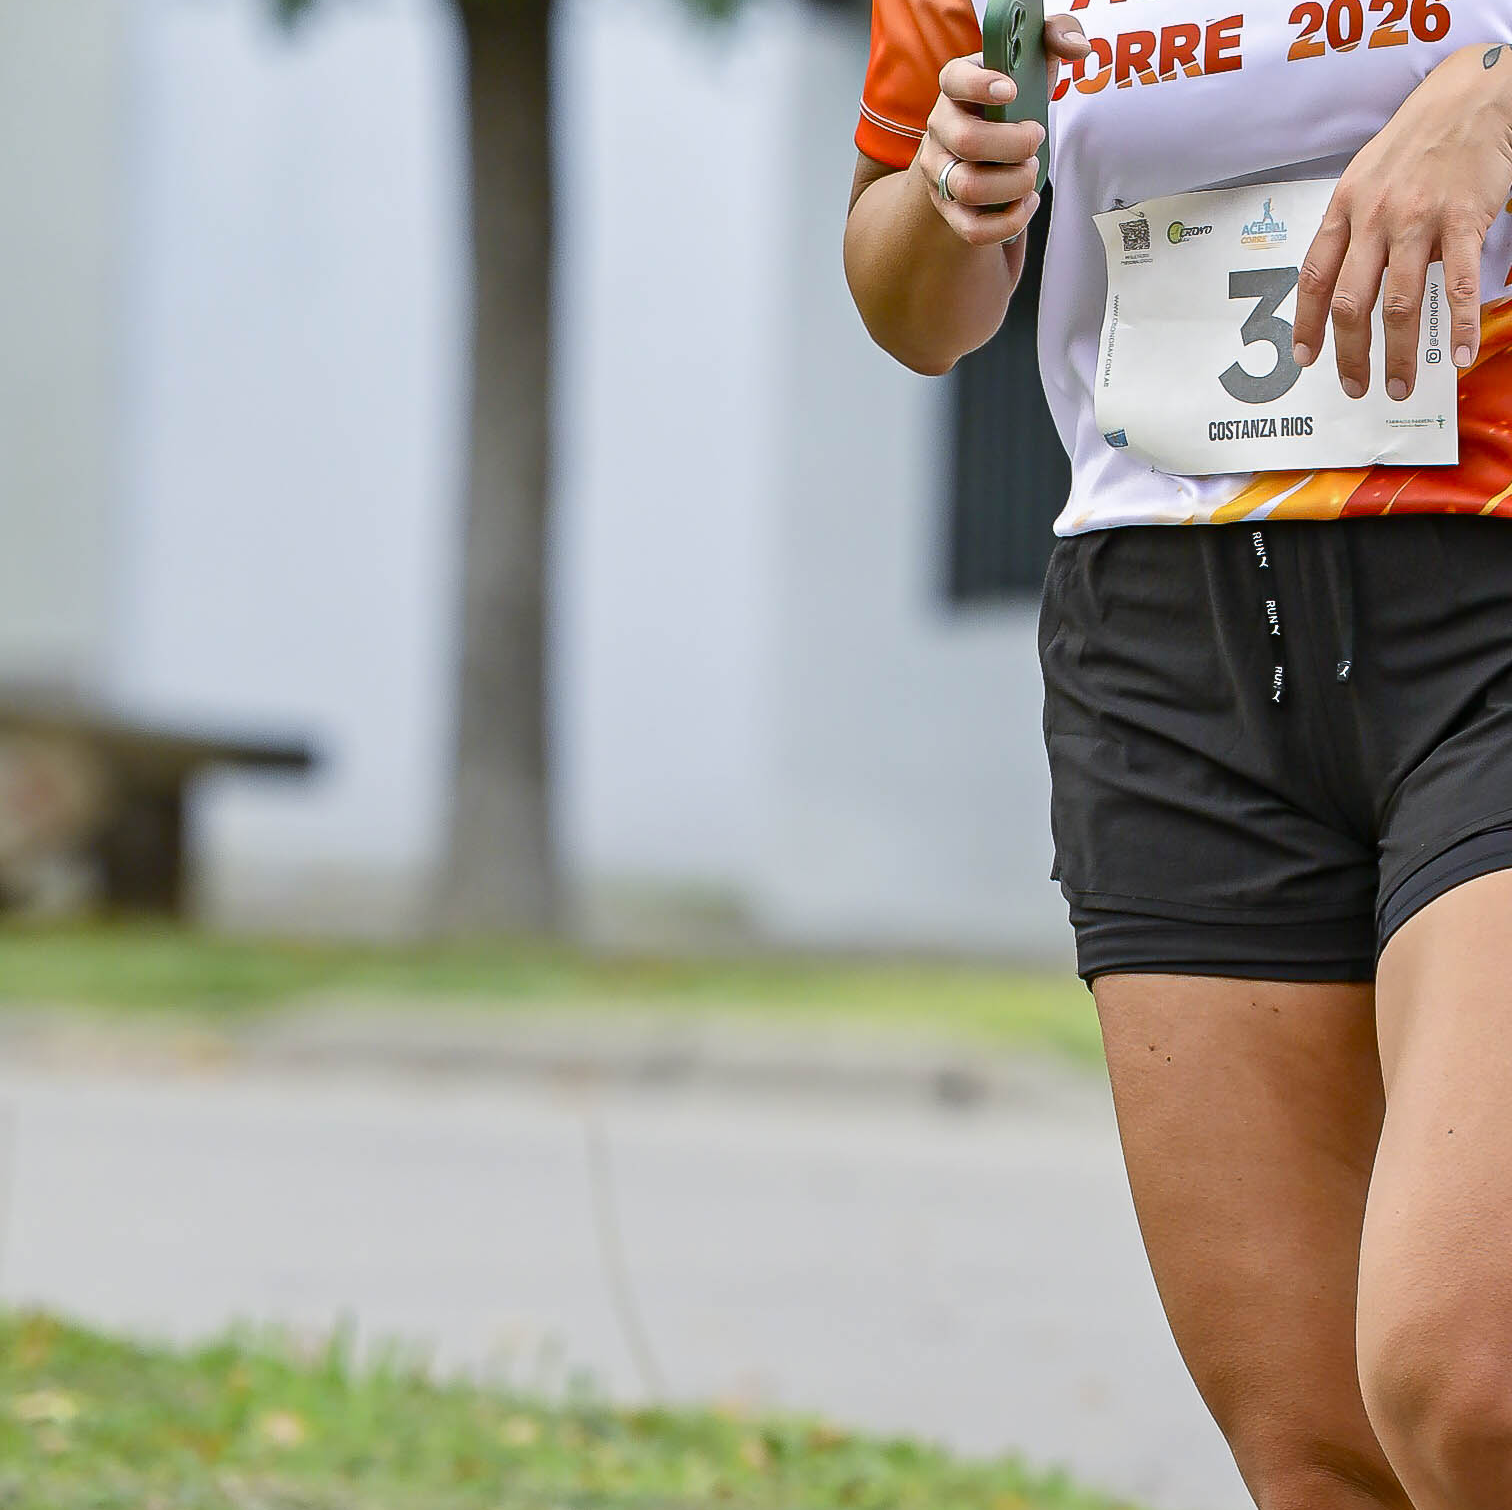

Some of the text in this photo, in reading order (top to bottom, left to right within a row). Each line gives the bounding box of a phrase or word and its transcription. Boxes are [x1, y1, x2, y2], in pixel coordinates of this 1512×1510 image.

[1429, 282, 1440, 347] @CRONORAV
[1217, 266, 1306, 405] 3
[1208, 416, 1314, 442] COSTANZA RIOS
[1252, 531, 1266, 557] RUN
[1265, 600, 1279, 624] RUN
